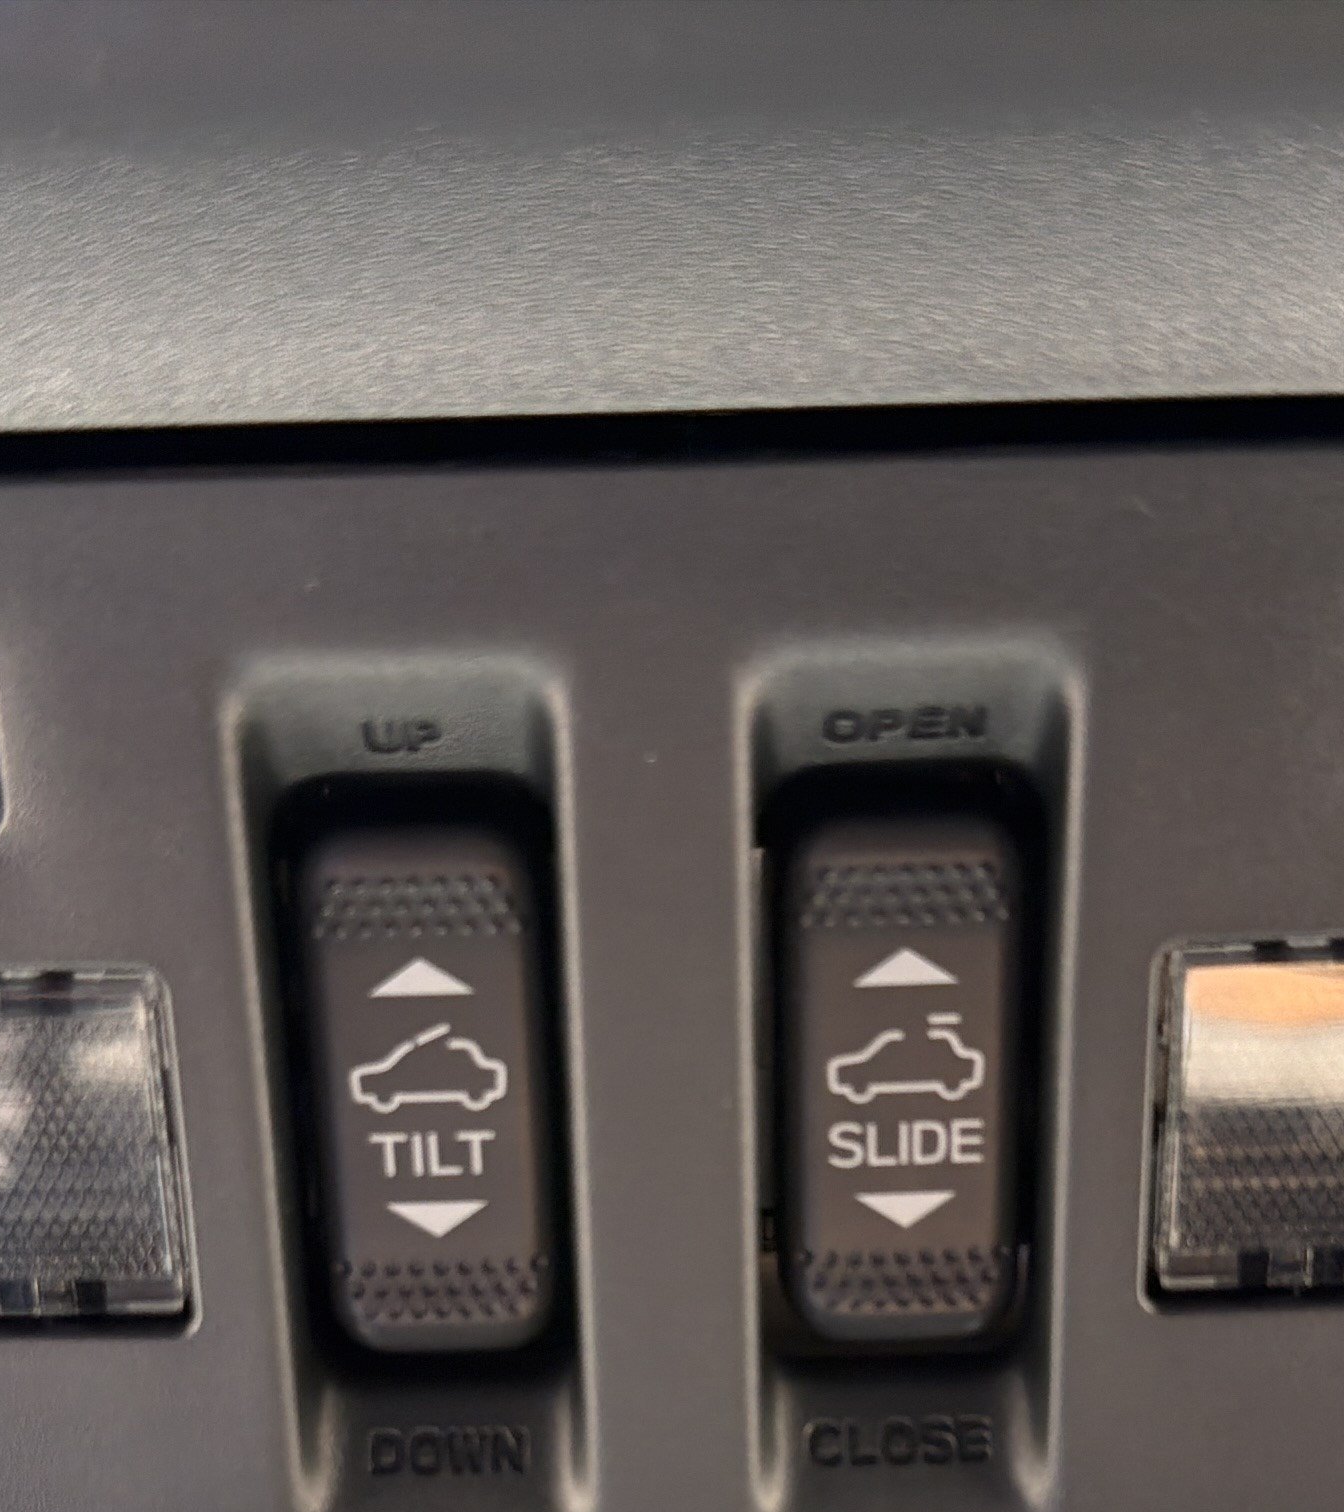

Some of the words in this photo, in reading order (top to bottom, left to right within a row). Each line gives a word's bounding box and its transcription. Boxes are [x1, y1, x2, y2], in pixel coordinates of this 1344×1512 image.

[361, 715, 443, 753] UP
[822, 706, 988, 743] OPEN
[368, 1129, 496, 1177] TILT
[827, 1118, 985, 1168] SLIDE
[368, 1425, 531, 1475] DOWN
[804, 1415, 992, 1467] CLOSE
